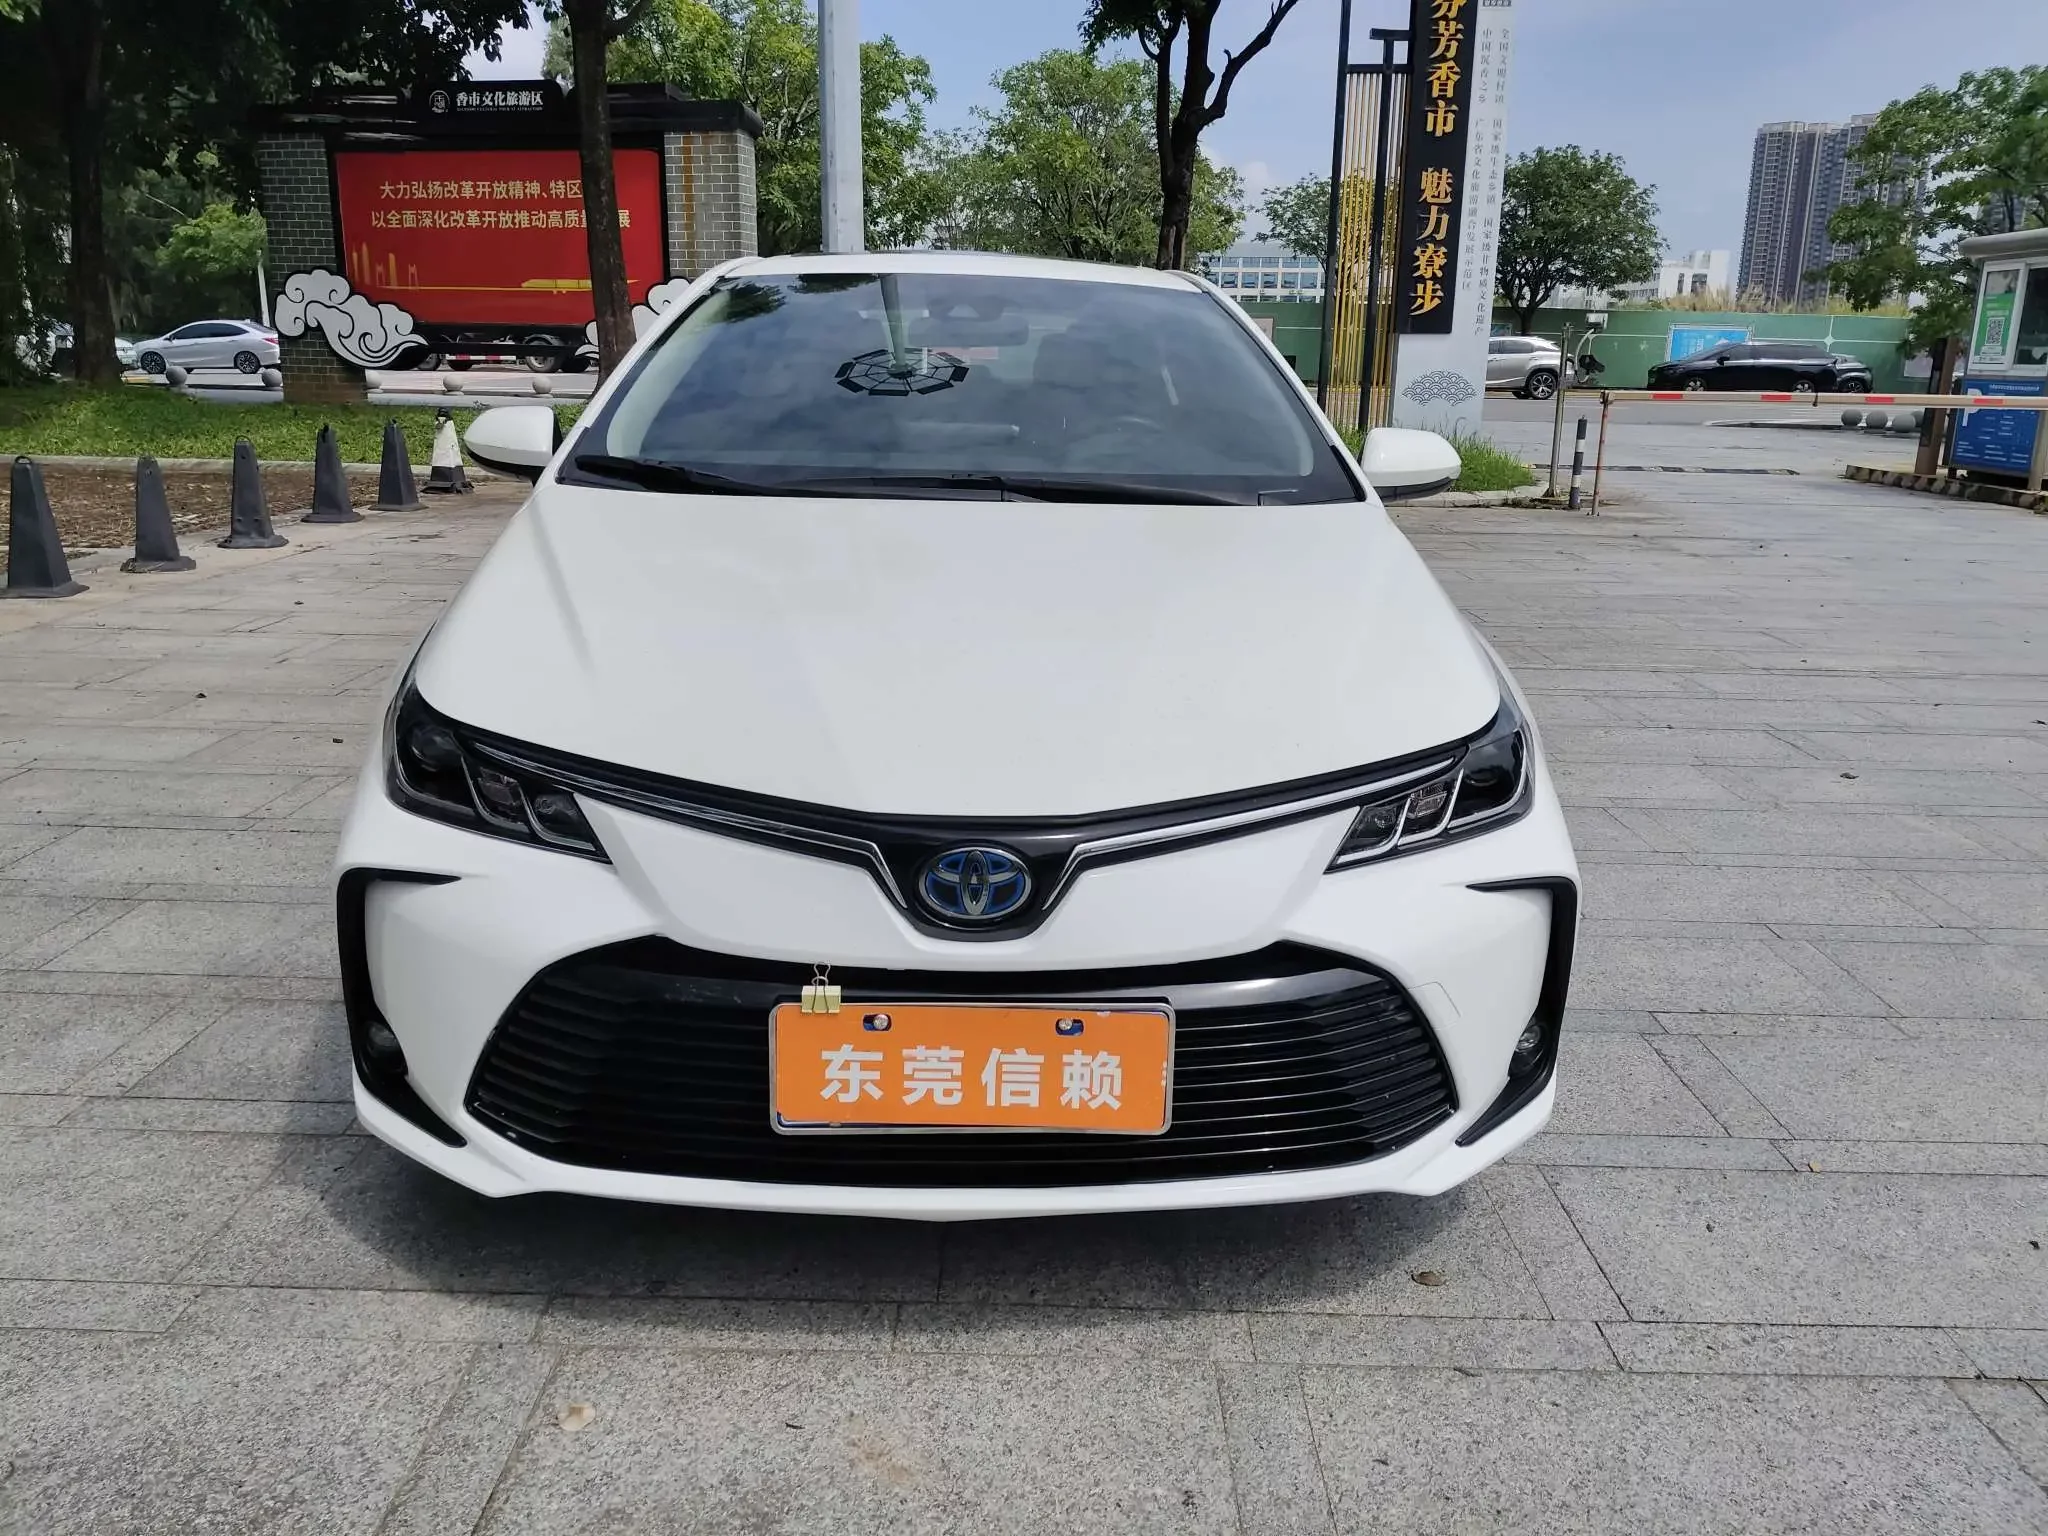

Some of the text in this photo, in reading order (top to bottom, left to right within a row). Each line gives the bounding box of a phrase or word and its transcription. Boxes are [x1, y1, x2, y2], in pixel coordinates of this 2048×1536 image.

[456, 91, 543, 106] 香市文化旅游区
[380, 180, 584, 200] 大力弘扬改革开放精神、特区
[371, 209, 631, 229] 以全面深化改革开放推动高质展
[1409, 167, 1453, 316] 魅力寮步
[820, 1043, 1122, 1111] 东莞信赖
